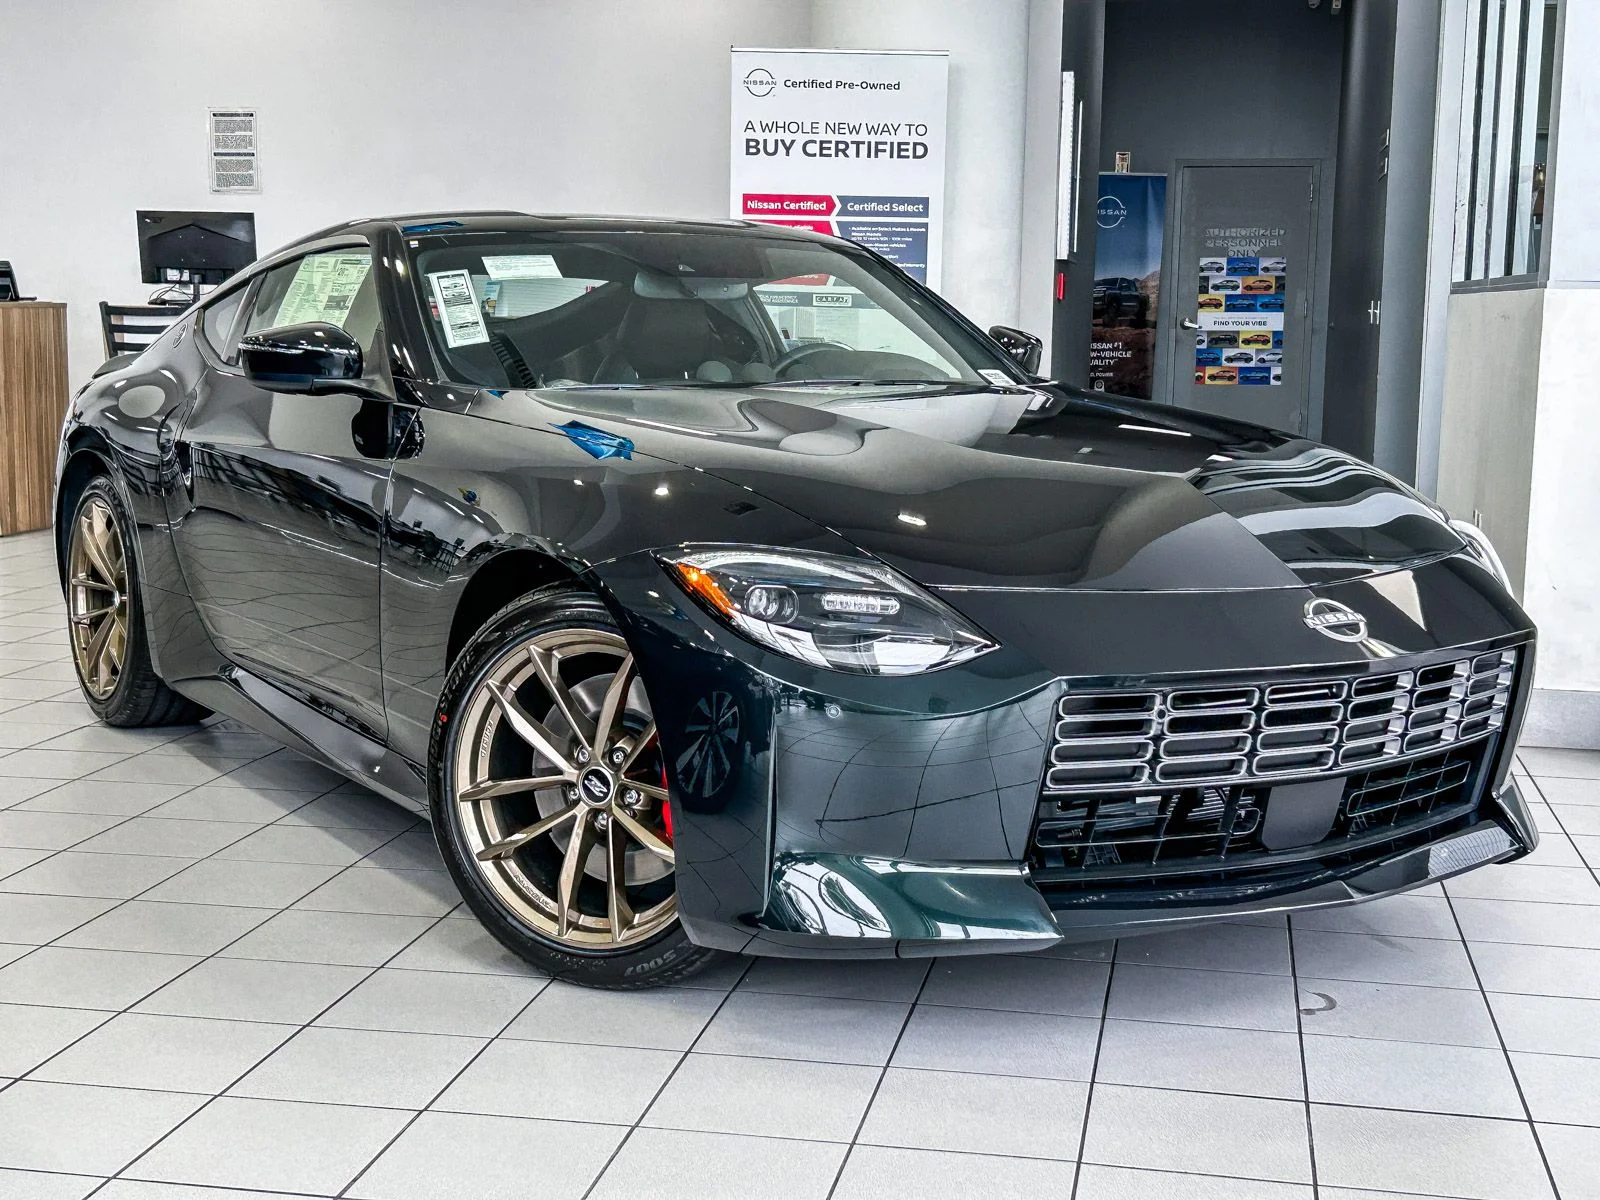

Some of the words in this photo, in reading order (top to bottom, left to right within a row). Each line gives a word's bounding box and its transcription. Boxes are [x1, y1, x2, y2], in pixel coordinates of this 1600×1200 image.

[783, 79, 833, 89] Certified
[835, 80, 901, 91] Pre-Owned
[743, 120, 756, 133] A
[759, 120, 820, 135] WHOLE
[825, 121, 862, 136] NEW
[865, 122, 901, 136] WAY
[904, 123, 928, 137] TO
[745, 138, 797, 157] BUY
[801, 139, 929, 160] CERTIFIED
[747, 200, 781, 209] Nissan
[783, 201, 827, 210] Certified
[847, 202, 890, 212] Certified
[892, 203, 924, 213] Select
[1204, 228, 1286, 237] AUTHORIZED
[1205, 239, 1281, 248] PERSONNEL
[1227, 249, 1260, 258] ONLY
[1304, 613, 1367, 627] NISSAN
